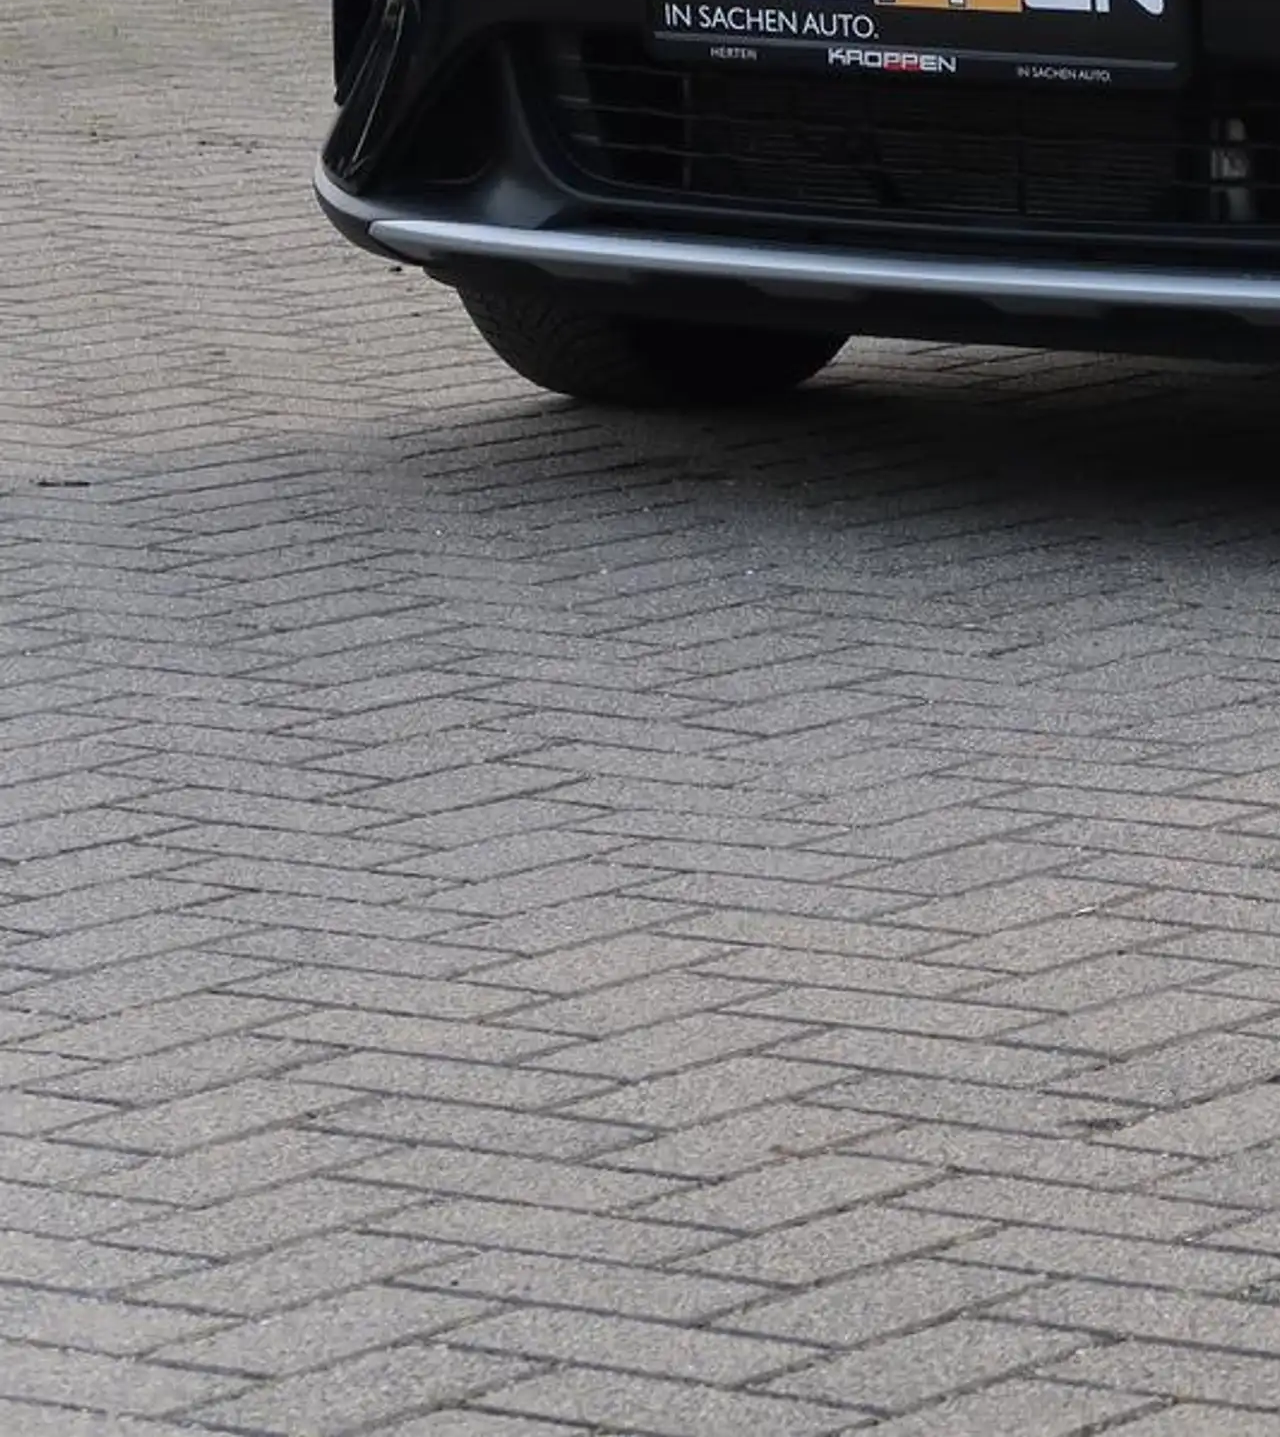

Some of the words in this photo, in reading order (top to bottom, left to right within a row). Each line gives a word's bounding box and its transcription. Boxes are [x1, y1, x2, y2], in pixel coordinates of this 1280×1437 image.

[664, 3, 692, 27] IN
[698, 5, 798, 34] SACHEN
[827, 47, 957, 73] KROPPEN
